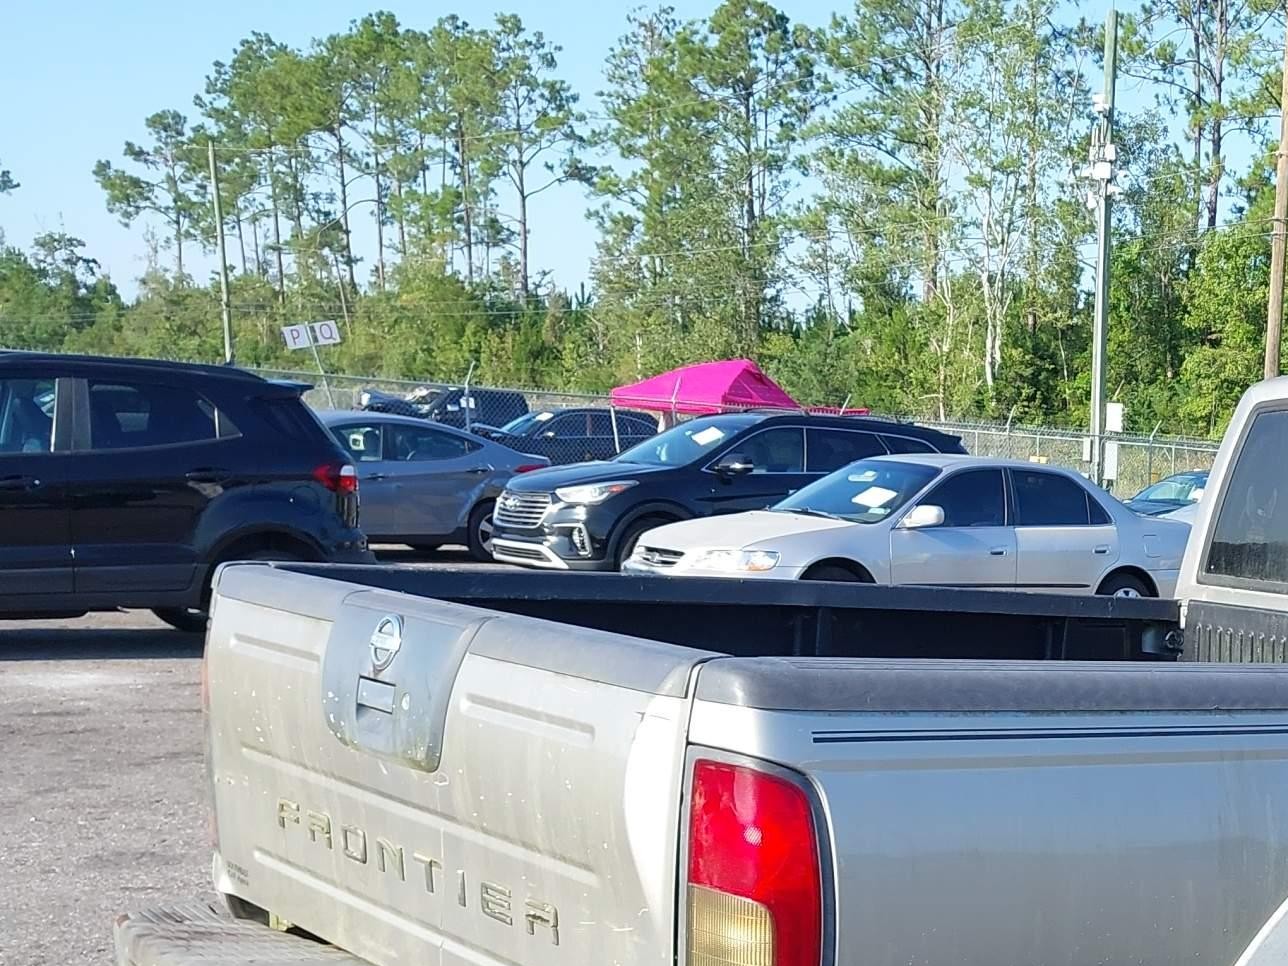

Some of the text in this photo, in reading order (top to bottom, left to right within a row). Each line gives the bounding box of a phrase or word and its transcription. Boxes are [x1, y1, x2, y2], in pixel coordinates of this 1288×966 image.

[290, 328, 300, 345] P
[320, 323, 336, 341] Q
[277, 797, 560, 947] FRONTIER
